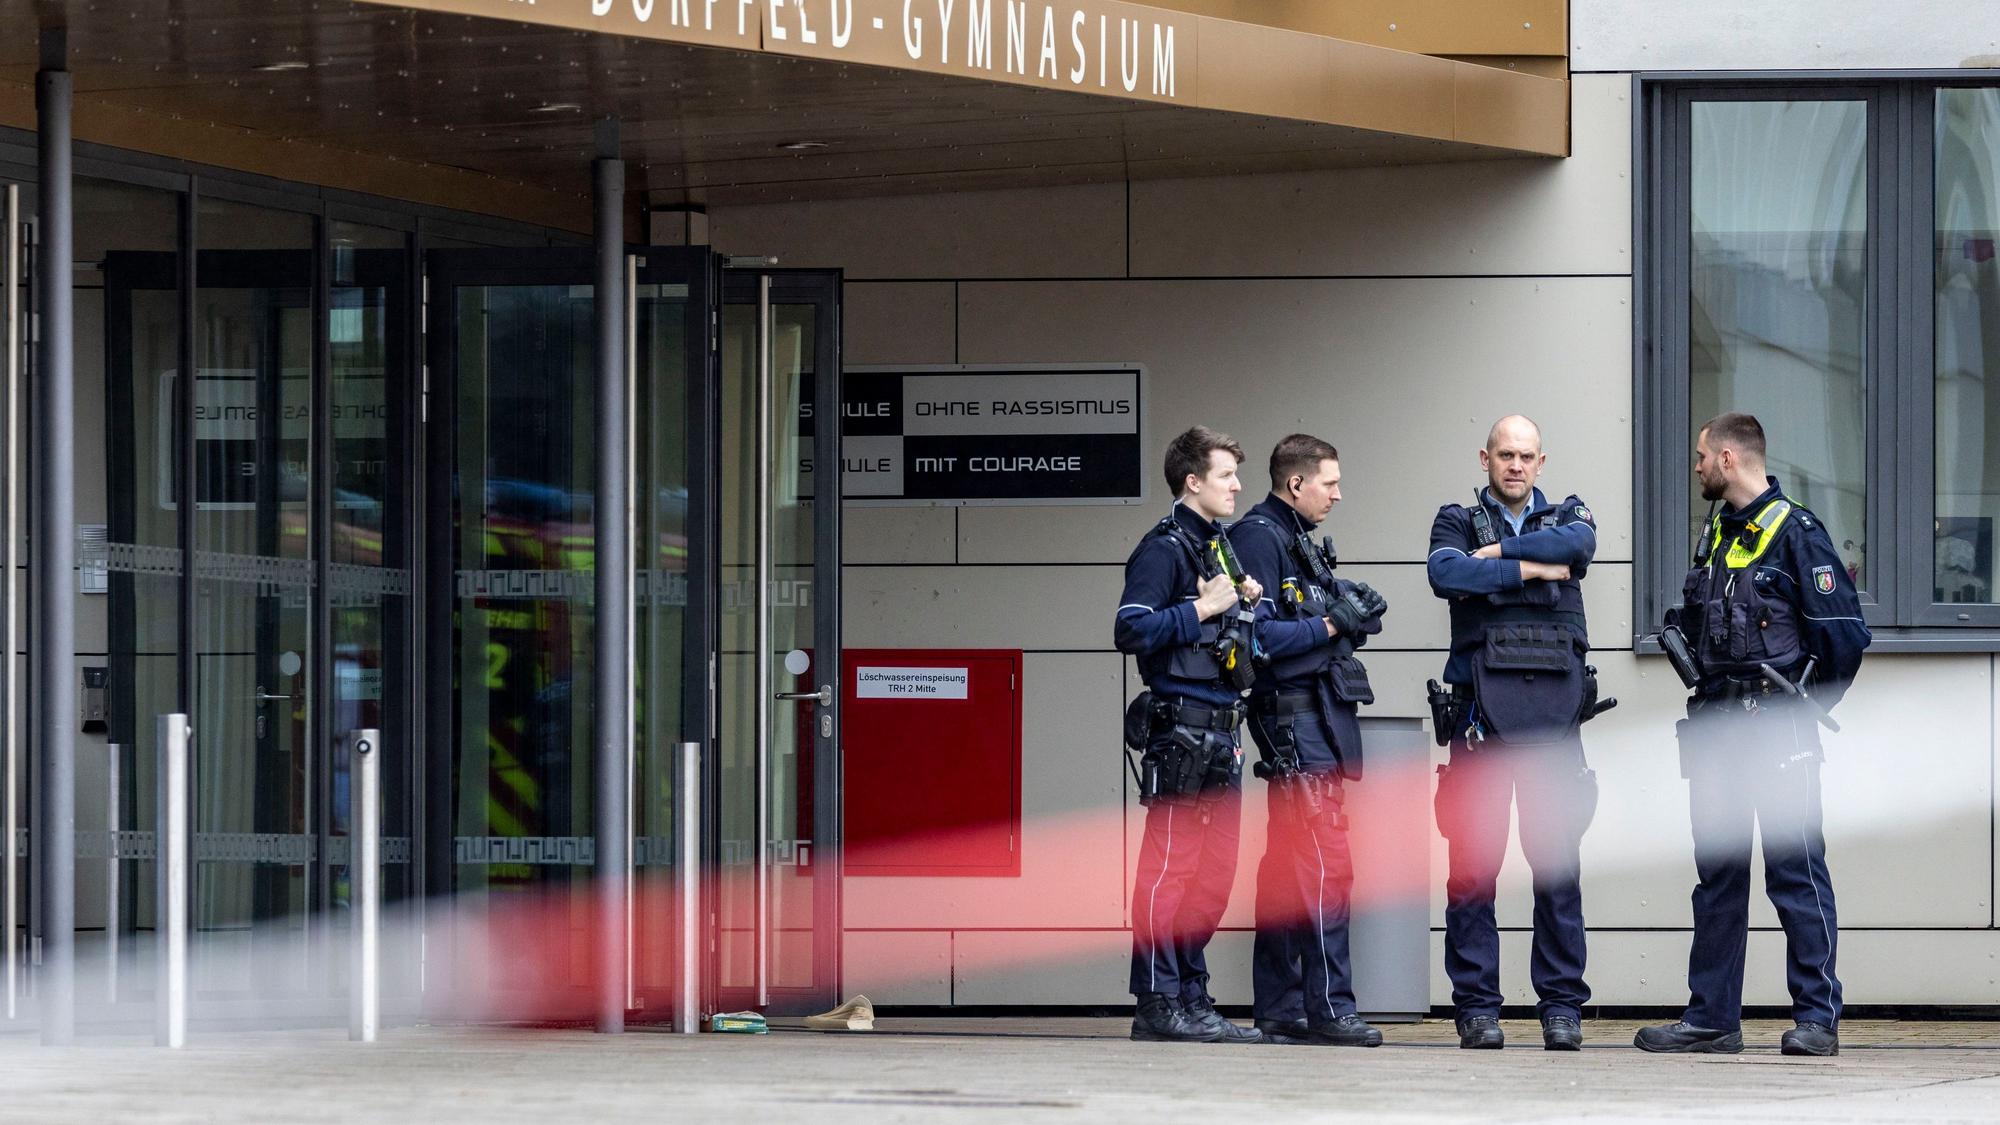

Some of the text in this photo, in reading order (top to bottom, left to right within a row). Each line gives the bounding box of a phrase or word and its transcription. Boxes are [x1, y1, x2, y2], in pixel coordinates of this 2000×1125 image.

[799, 400, 1130, 418] SULE OHNE RASSISMUS
[799, 456, 1082, 473] SULE MIT COURAGE
[859, 672, 966, 684] Löschwassereinspeisung
[888, 684, 937, 693] TRH 2 Mitte
